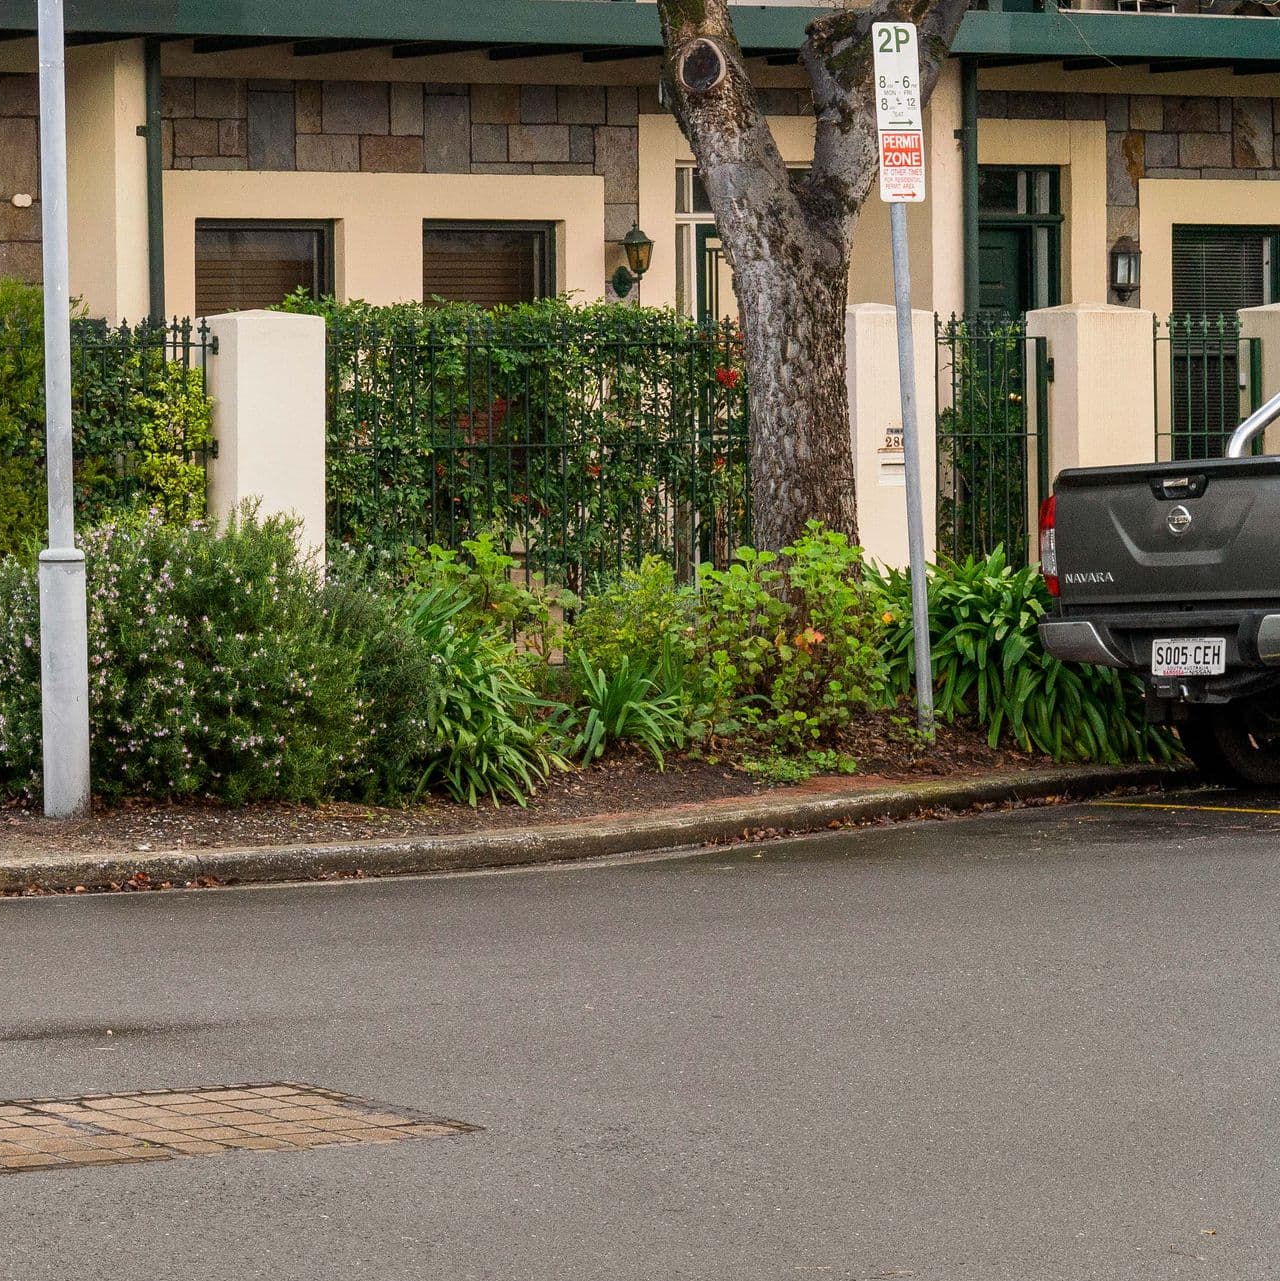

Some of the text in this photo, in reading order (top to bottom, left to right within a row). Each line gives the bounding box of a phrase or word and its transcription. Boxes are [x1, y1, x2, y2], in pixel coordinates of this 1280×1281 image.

[877, 26, 910, 53] 2P
[883, 135, 920, 149] PERMIT
[884, 151, 921, 166] ZONE
[1065, 571, 1114, 584] NAVARA
